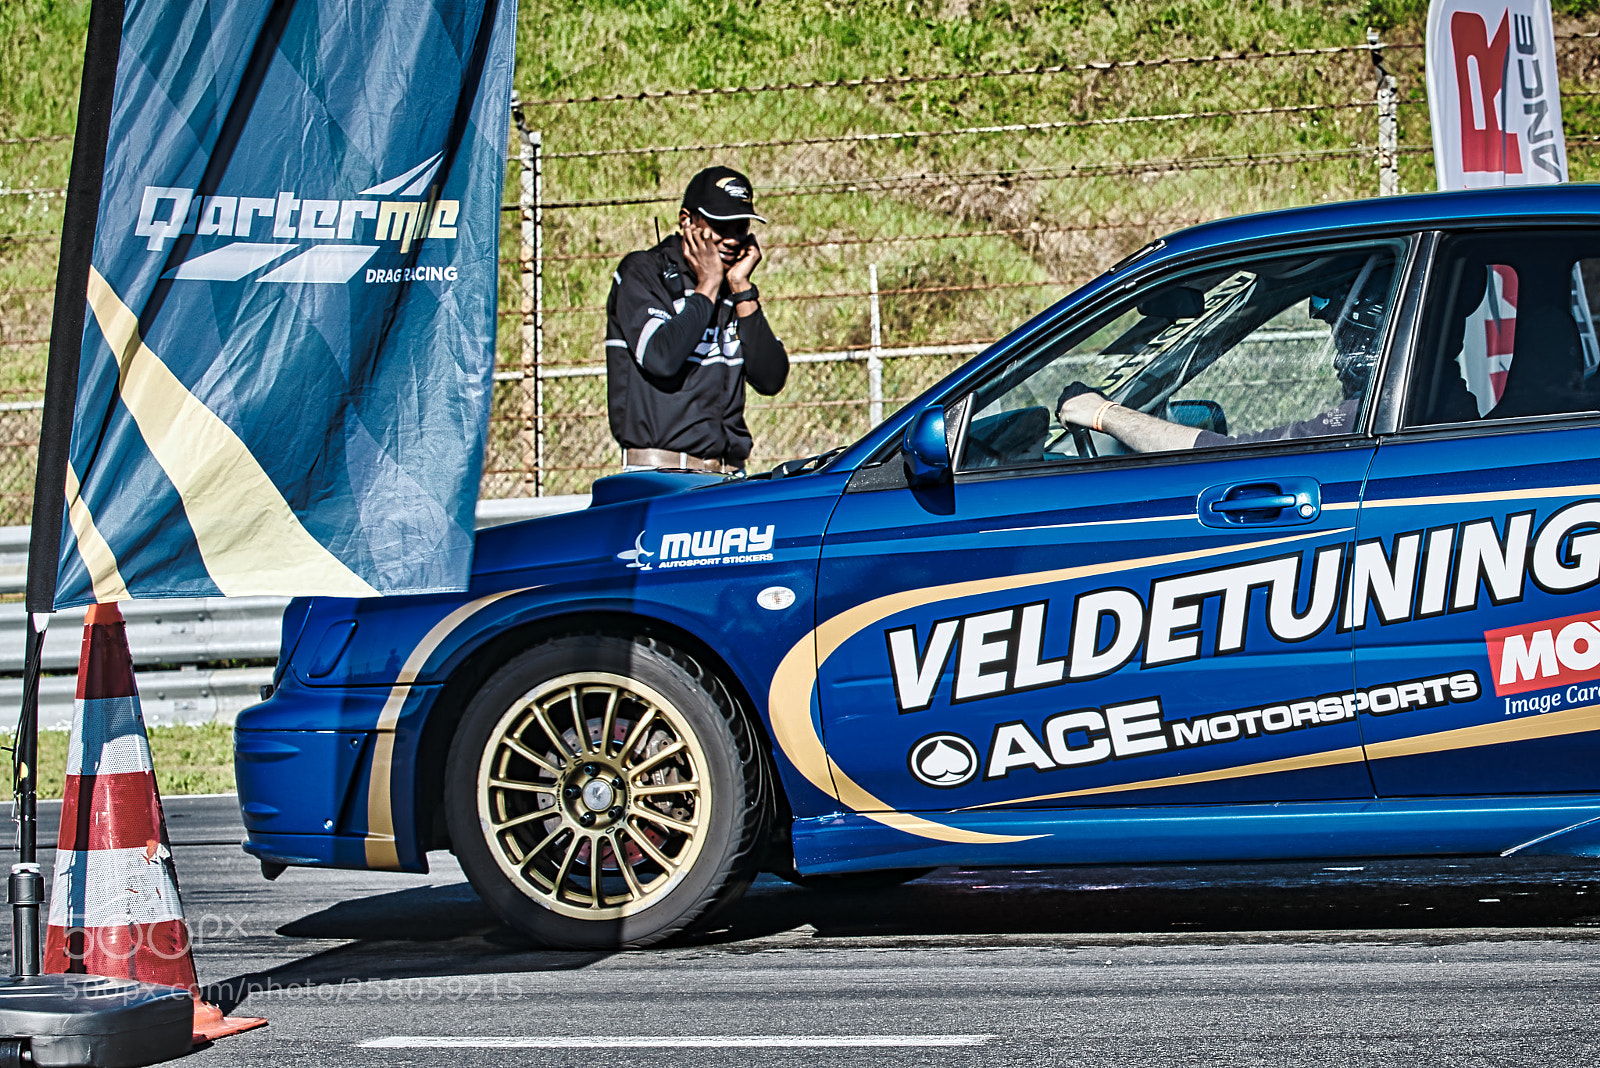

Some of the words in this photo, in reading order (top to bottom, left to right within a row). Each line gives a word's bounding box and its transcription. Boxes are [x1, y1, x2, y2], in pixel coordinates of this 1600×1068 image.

[366, 269, 402, 284] DRAG
[660, 525, 775, 559] MWAY
[659, 557, 720, 569] AUTOSPORT
[722, 552, 774, 564] STICKERS
[887, 504, 1600, 711] VELDETUNING
[1499, 619, 1600, 686] MO
[1505, 693, 1562, 715] Image
[1566, 685, 1600, 704] Car
[987, 700, 1167, 777] ACE
[1173, 674, 1479, 746] MOTORSPORTS
